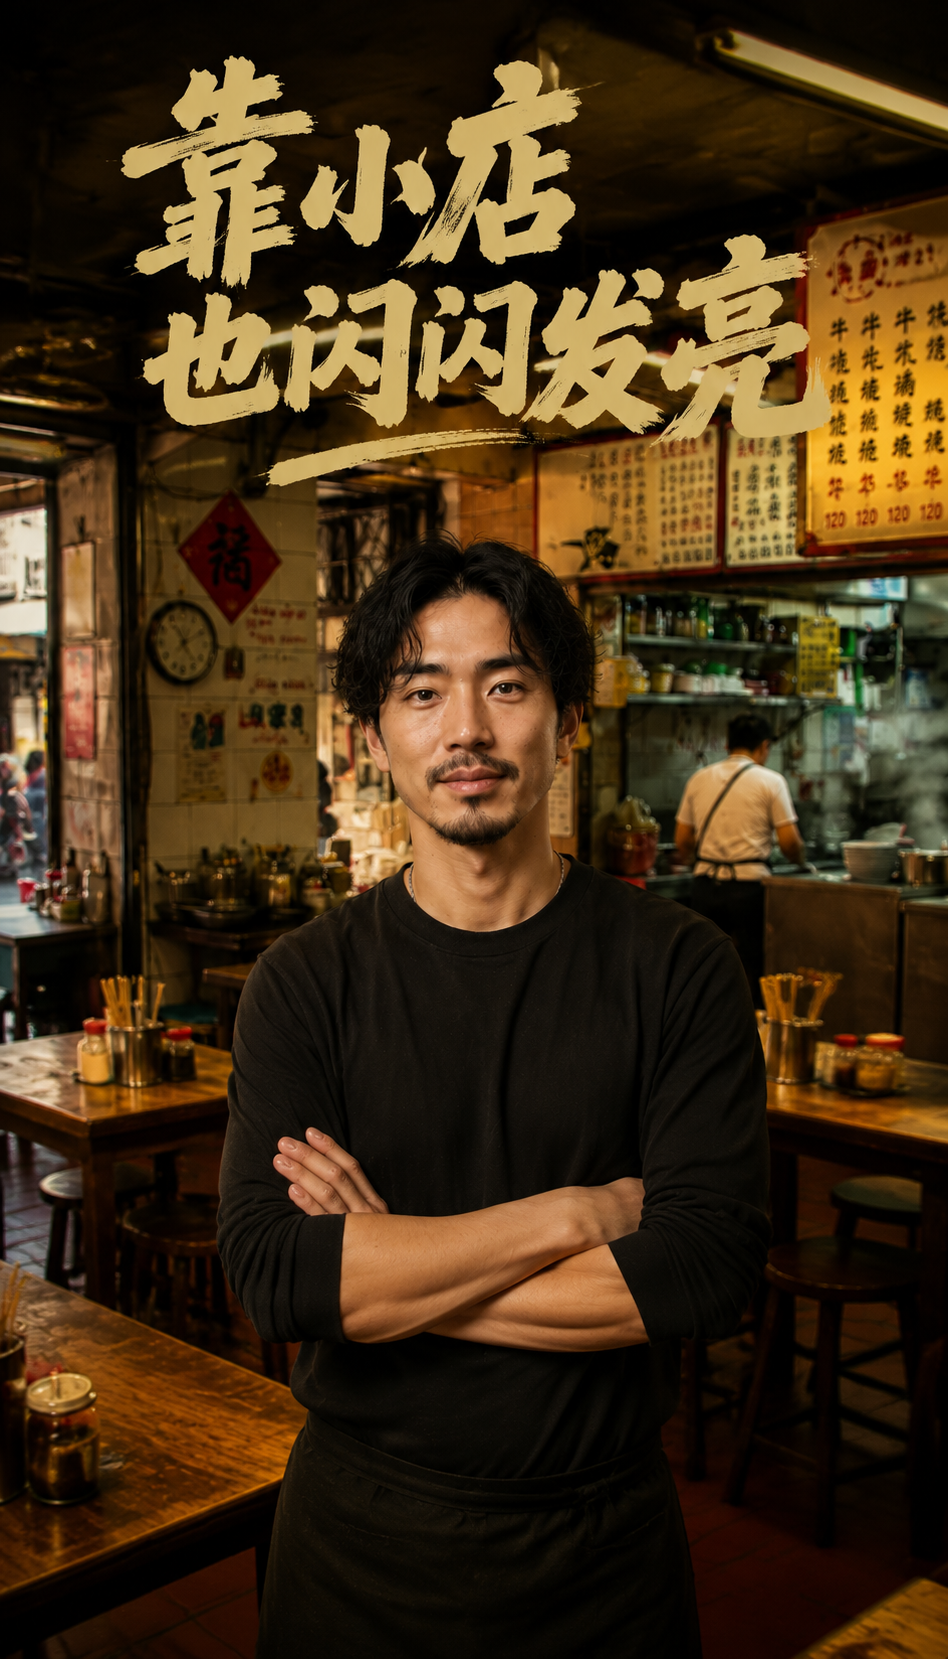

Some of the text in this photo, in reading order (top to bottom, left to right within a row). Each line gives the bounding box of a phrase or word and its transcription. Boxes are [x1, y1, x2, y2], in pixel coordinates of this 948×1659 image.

[825, 502, 943, 529] 120 120 120 120
